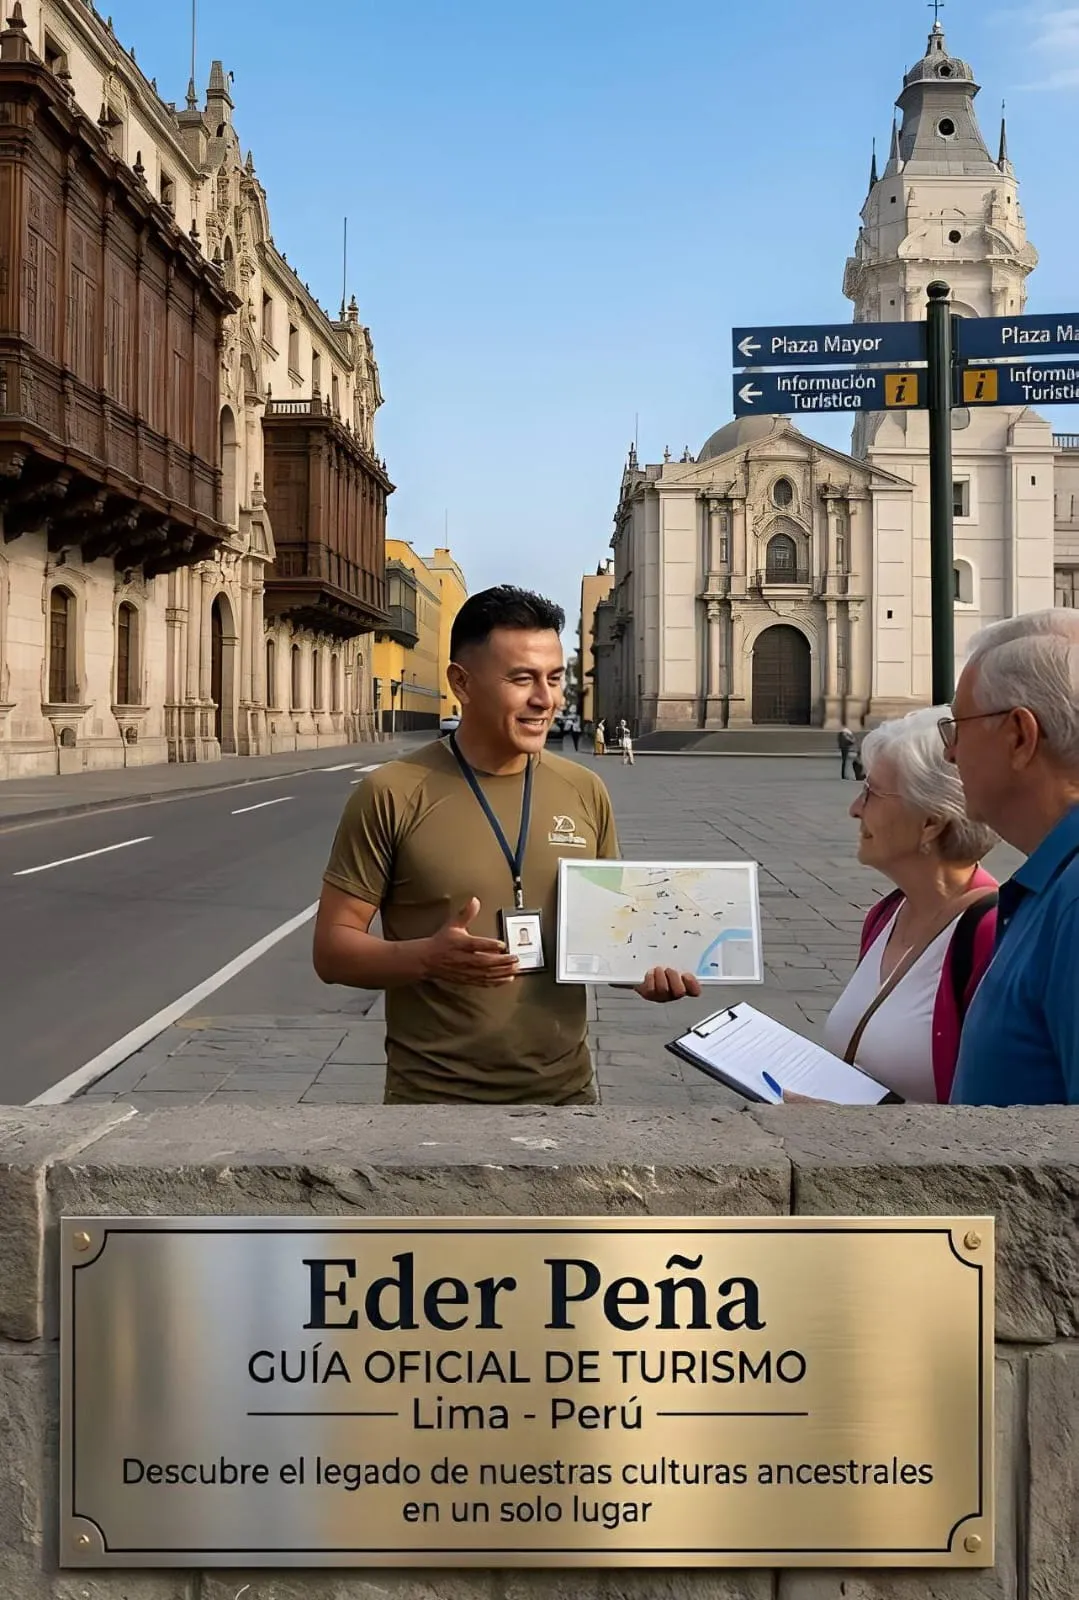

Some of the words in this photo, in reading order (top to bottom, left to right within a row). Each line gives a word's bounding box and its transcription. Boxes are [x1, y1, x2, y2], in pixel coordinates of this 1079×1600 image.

[771, 336, 818, 354] Plaza
[824, 335, 883, 355] Mayor
[1002, 326, 1050, 344] Plaza
[777, 373, 876, 391] Información
[302, 1252, 517, 1332] Eder
[543, 1254, 767, 1332] Peña
[248, 1341, 352, 1385] GUÍA
[364, 1350, 531, 1384] OFICIAL
[545, 1351, 601, 1384] DE
[613, 1350, 807, 1384] TURISMO
[413, 1396, 509, 1430] Lima
[551, 1396, 642, 1430] Perú
[122, 1456, 270, 1486] Descubre
[279, 1456, 305, 1486] el
[316, 1456, 421, 1493] legado
[430, 1456, 469, 1486] de
[479, 1459, 613, 1486] nuestras
[621, 1456, 748, 1486] culturas
[757, 1456, 934, 1486] ancestrales
[403, 1501, 440, 1524] en
[451, 1502, 490, 1524] un
[499, 1494, 563, 1524] solo
[573, 1494, 653, 1531] lugar
